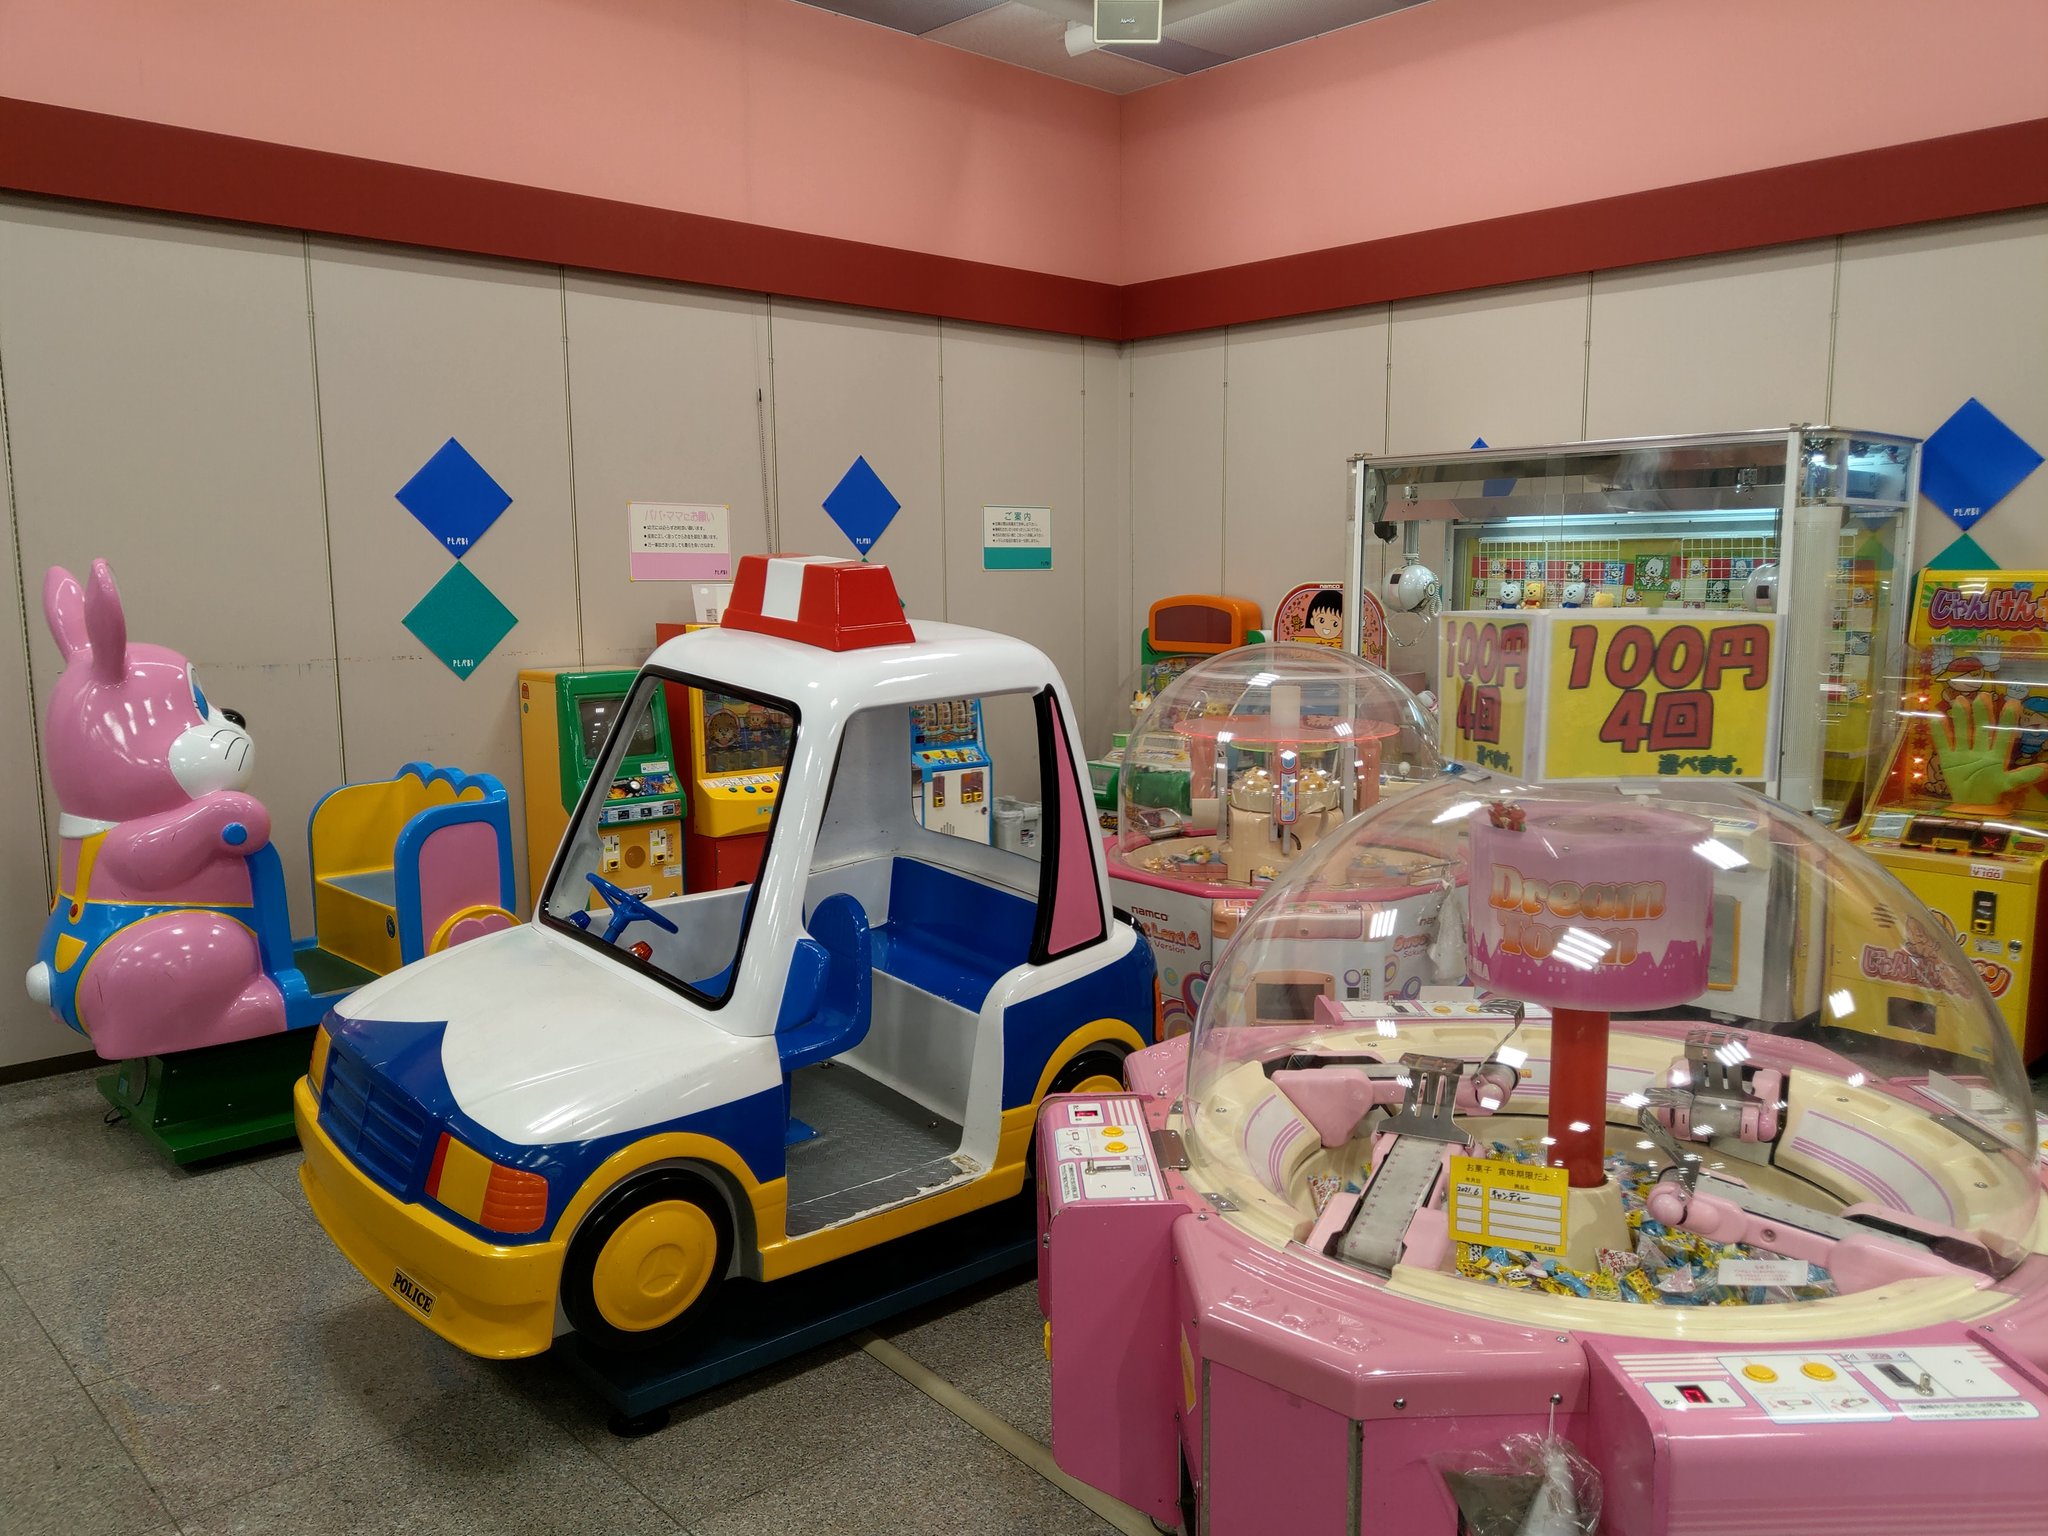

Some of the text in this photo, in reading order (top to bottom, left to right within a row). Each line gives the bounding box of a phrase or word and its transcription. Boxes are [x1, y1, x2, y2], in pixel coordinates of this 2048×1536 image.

[645, 509, 715, 522] パパ・ママにお願い
[1004, 511, 1031, 521] ご案内
[1953, 507, 1980, 516] PLABI
[446, 537, 469, 545] PLABI
[452, 659, 474, 667] PLABI
[1445, 620, 1530, 690] 100円
[1568, 623, 1771, 691] 100円
[1456, 681, 1502, 744] 4回
[1599, 688, 1715, 753] 4回
[1488, 862, 1667, 922] Dream
[1131, 906, 1169, 922] namco
[1151, 922, 1187, 947] Land
[1186, 929, 1202, 951] 4
[1497, 909, 1639, 967] Ton
[1154, 939, 1186, 955] Version
[1466, 1163, 1550, 1182] お菓子 賞味期限だよ
[1491, 1189, 1531, 1203] キャンディー
[1534, 1244, 1556, 1253] PLABI
[392, 1272, 433, 1313] POLICE
